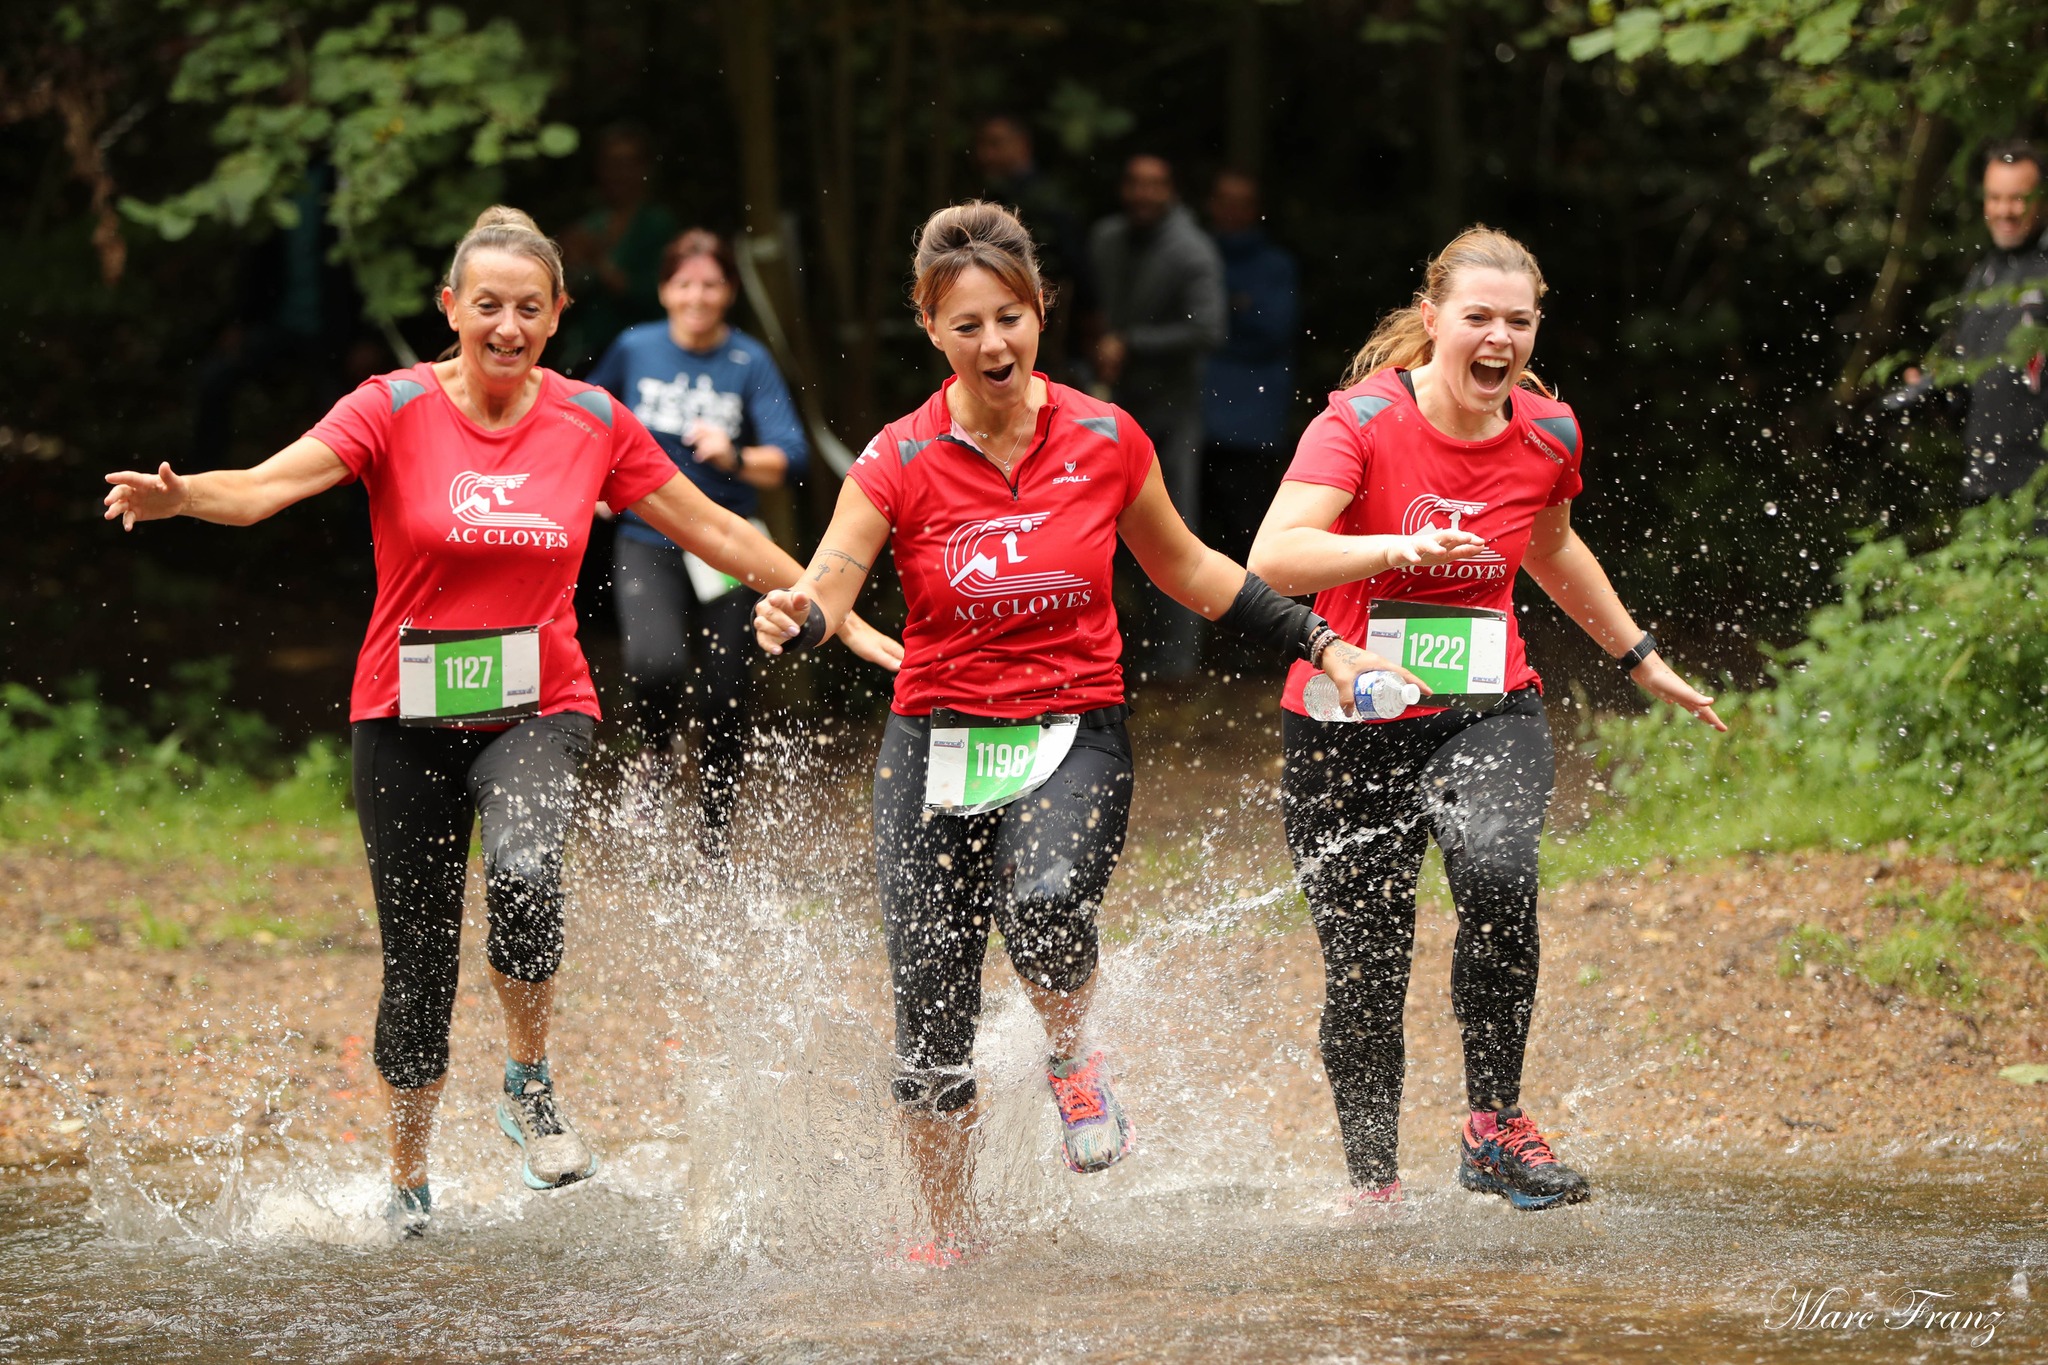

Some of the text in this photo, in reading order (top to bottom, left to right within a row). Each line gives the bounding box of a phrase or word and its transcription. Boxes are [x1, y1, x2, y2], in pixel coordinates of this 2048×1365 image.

[1052, 475, 1091, 485] SPALL
[445, 526, 569, 549] AC CLOYES
[1429, 563, 1507, 580] CLOYES
[954, 589, 1092, 621] AC CLOYES
[1409, 632, 1466, 671] 1222
[444, 655, 494, 689] 1127
[975, 742, 1031, 778] 1198
